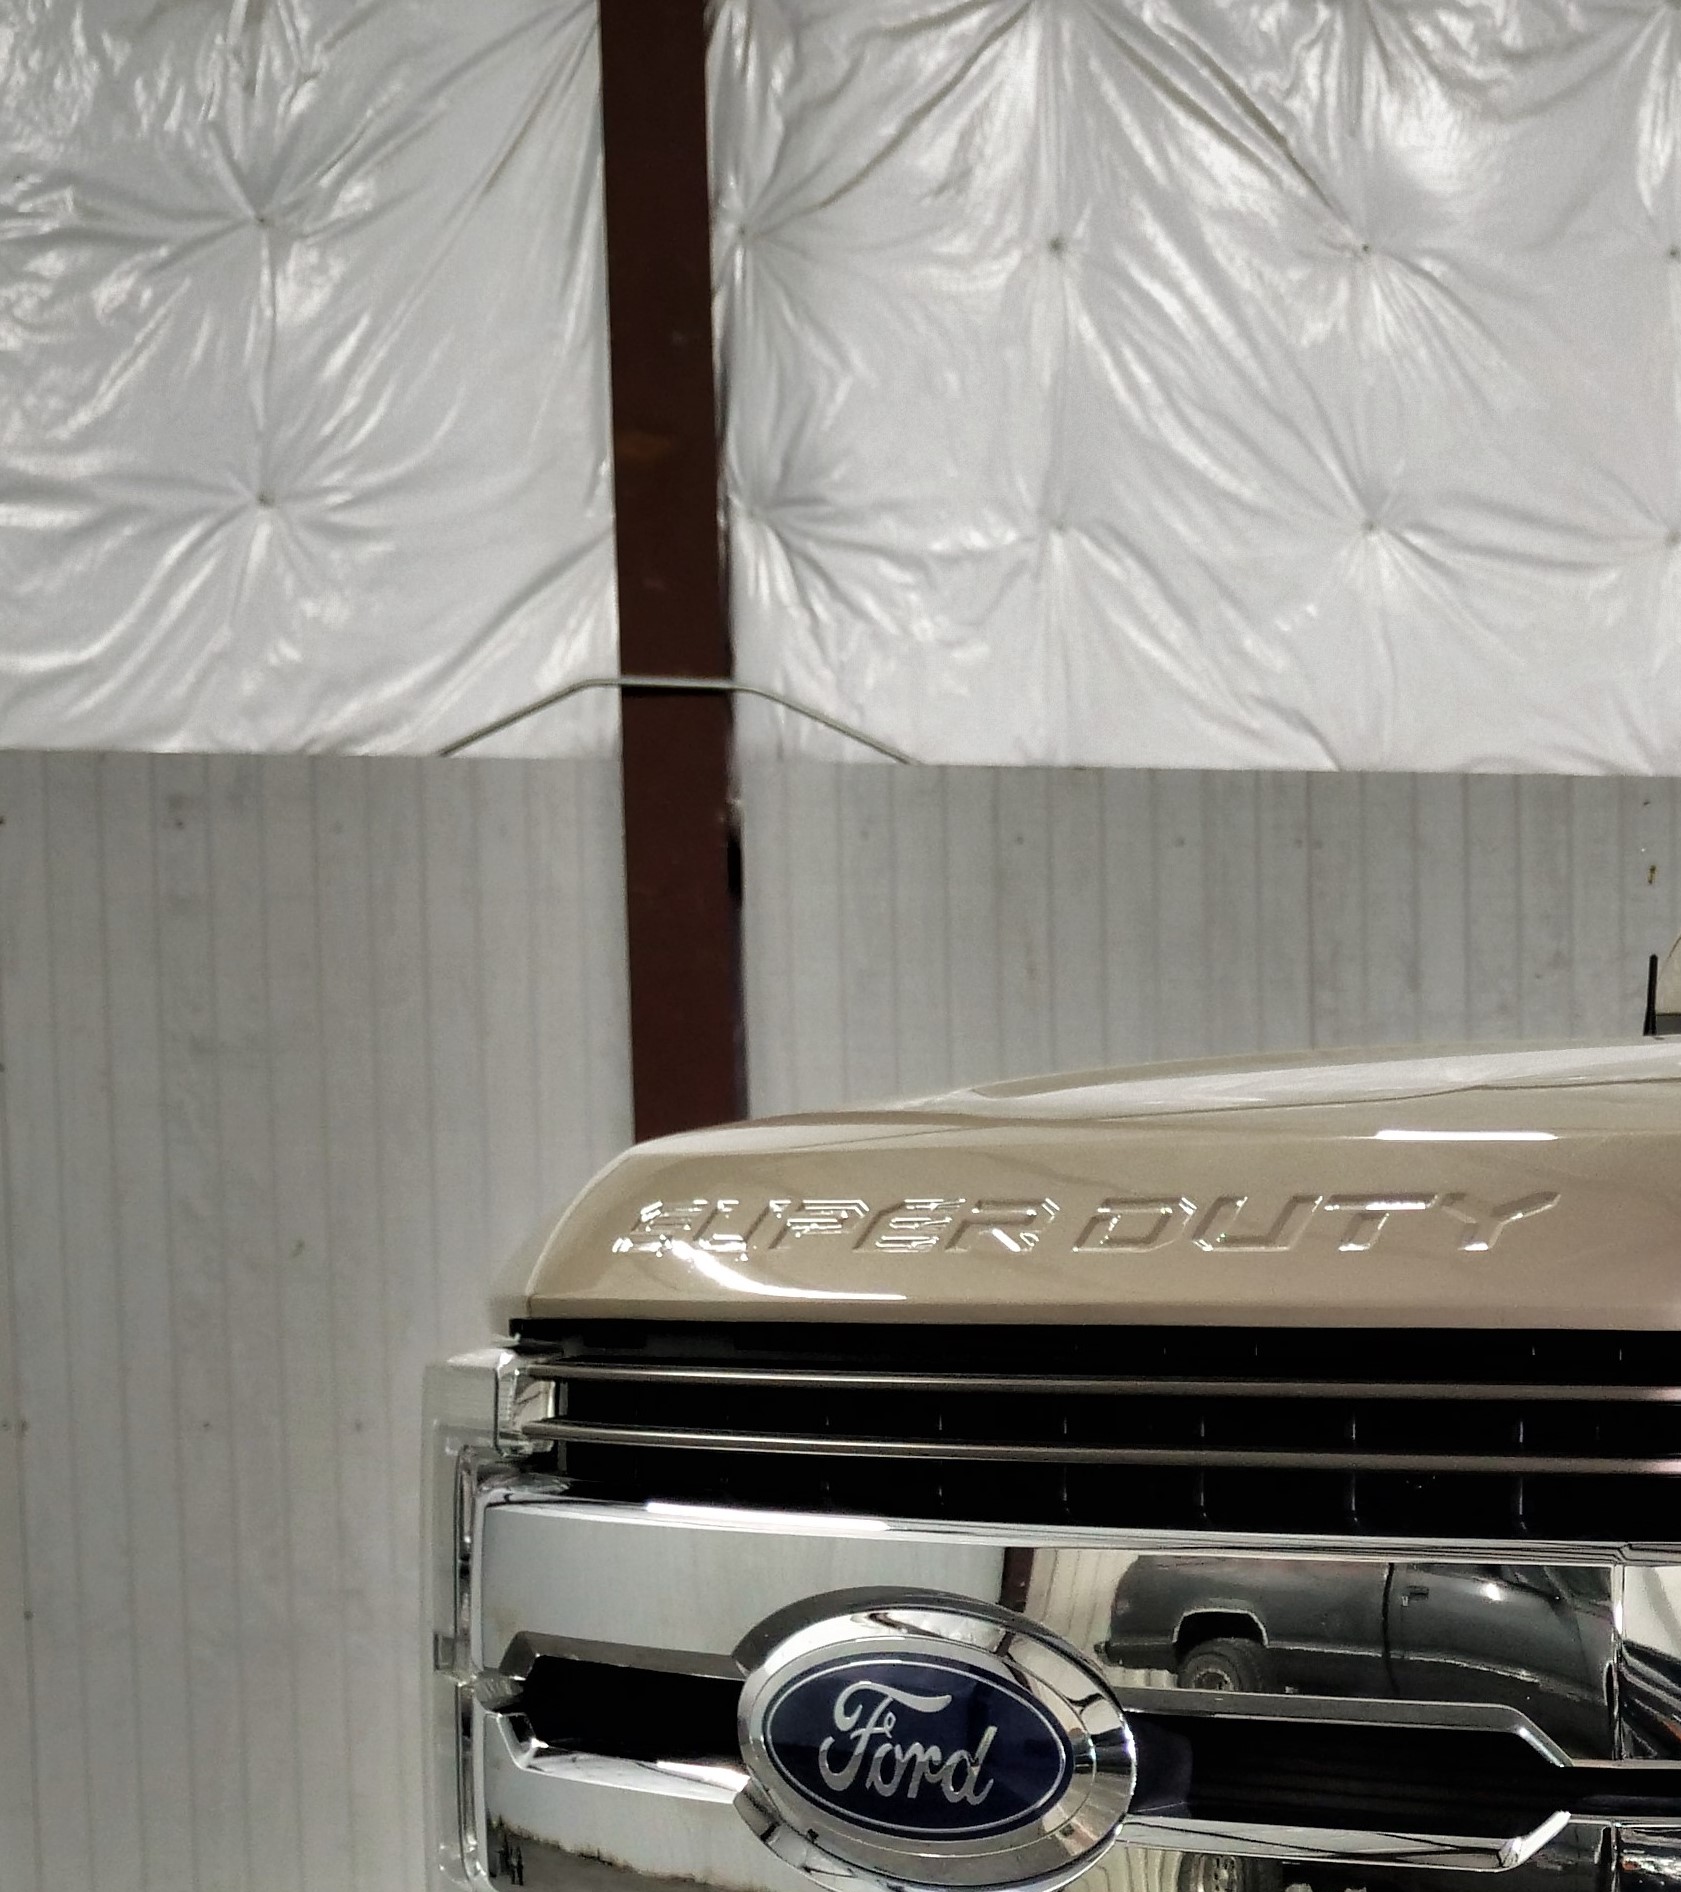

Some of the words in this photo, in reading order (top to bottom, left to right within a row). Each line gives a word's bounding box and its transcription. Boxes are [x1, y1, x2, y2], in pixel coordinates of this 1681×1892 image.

[611, 1196, 1062, 1255] SUPER
[1072, 1191, 1562, 1254] DUTY
[818, 1680, 999, 1806] Ford
